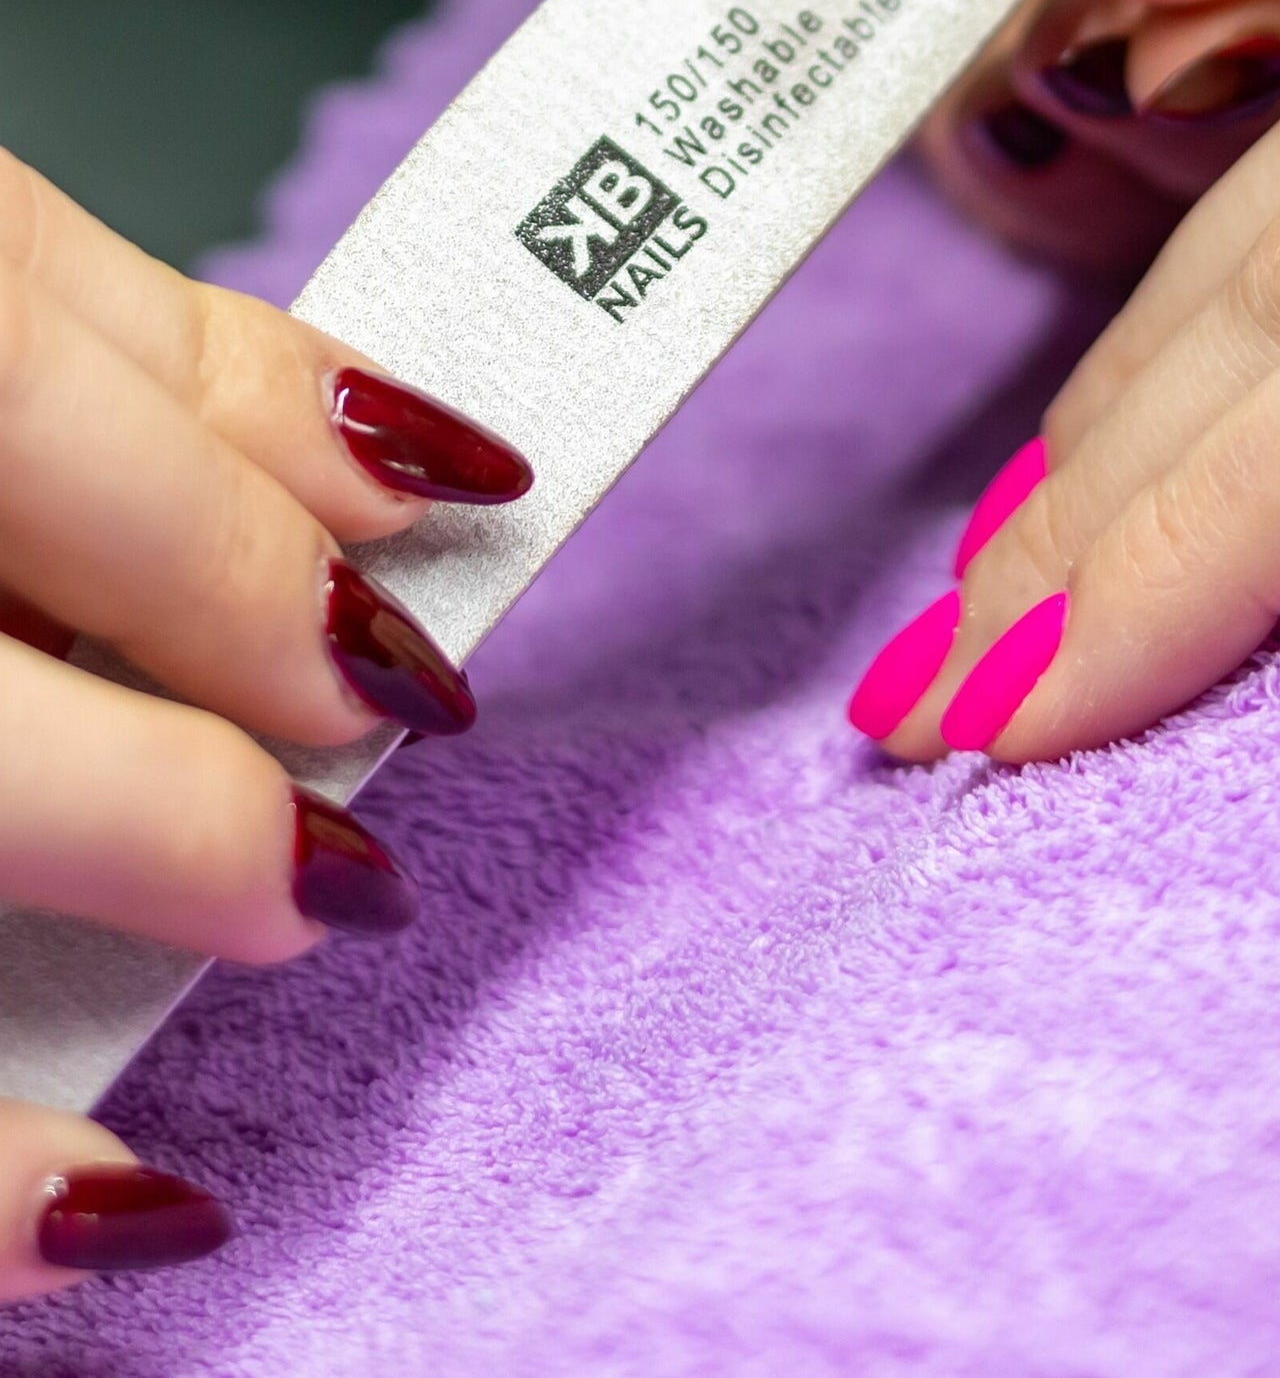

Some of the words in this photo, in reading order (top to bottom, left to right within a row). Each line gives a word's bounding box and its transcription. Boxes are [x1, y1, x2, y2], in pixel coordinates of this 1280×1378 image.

[635, 6, 760, 137] 150/150
[662, 9, 824, 168] Washable
[596, 206, 709, 324] NAILS
